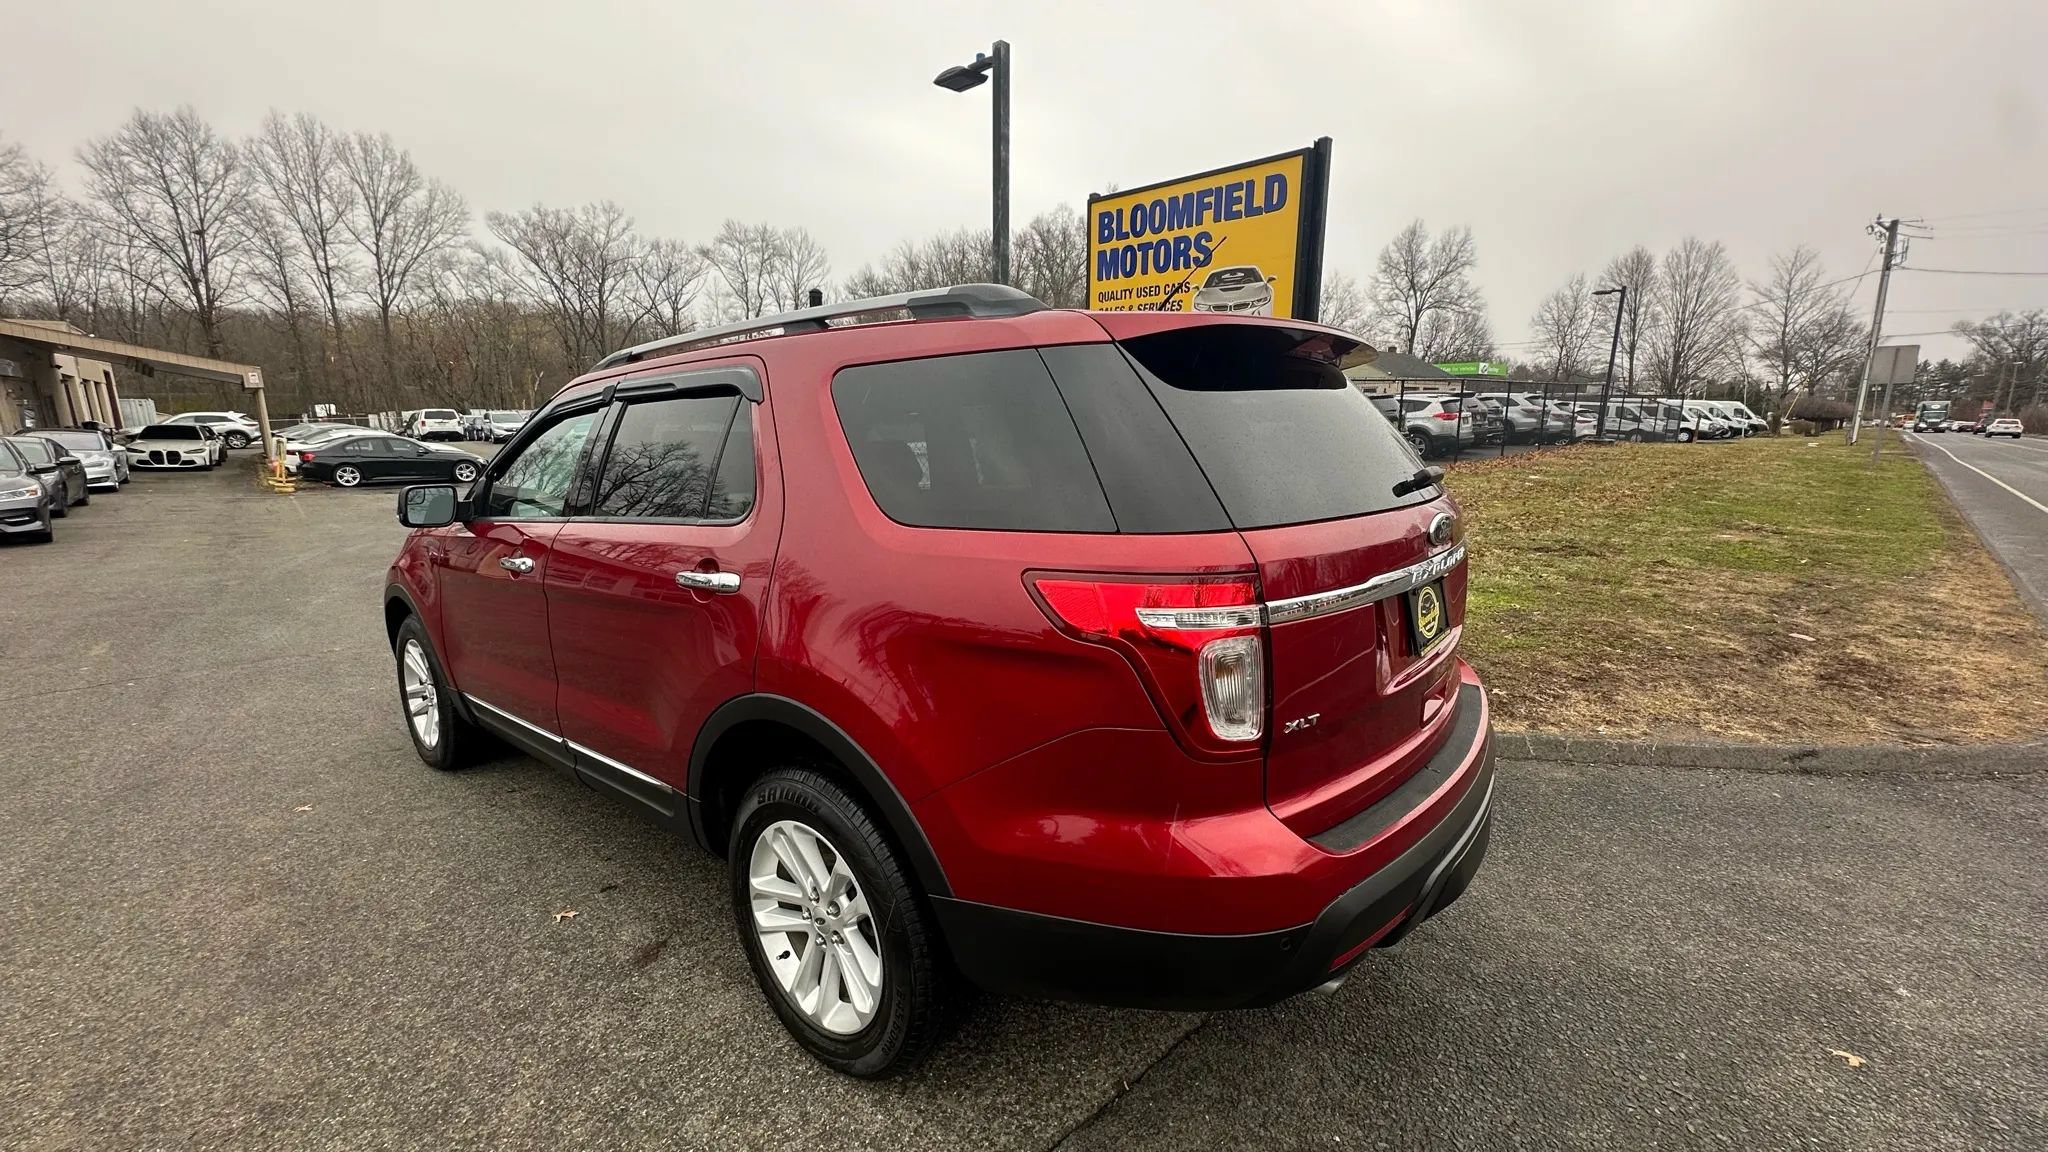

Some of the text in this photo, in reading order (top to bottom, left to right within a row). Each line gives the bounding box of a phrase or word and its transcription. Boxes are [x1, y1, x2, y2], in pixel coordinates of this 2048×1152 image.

[1097, 173, 1288, 244] BLOOMFIELD
[1096, 231, 1213, 282] MOTORS
[1098, 287, 1134, 303] QUALITY
[1136, 285, 1160, 299] USED
[1137, 299, 1184, 312] SERVCES
[1283, 713, 1321, 734] XLT
